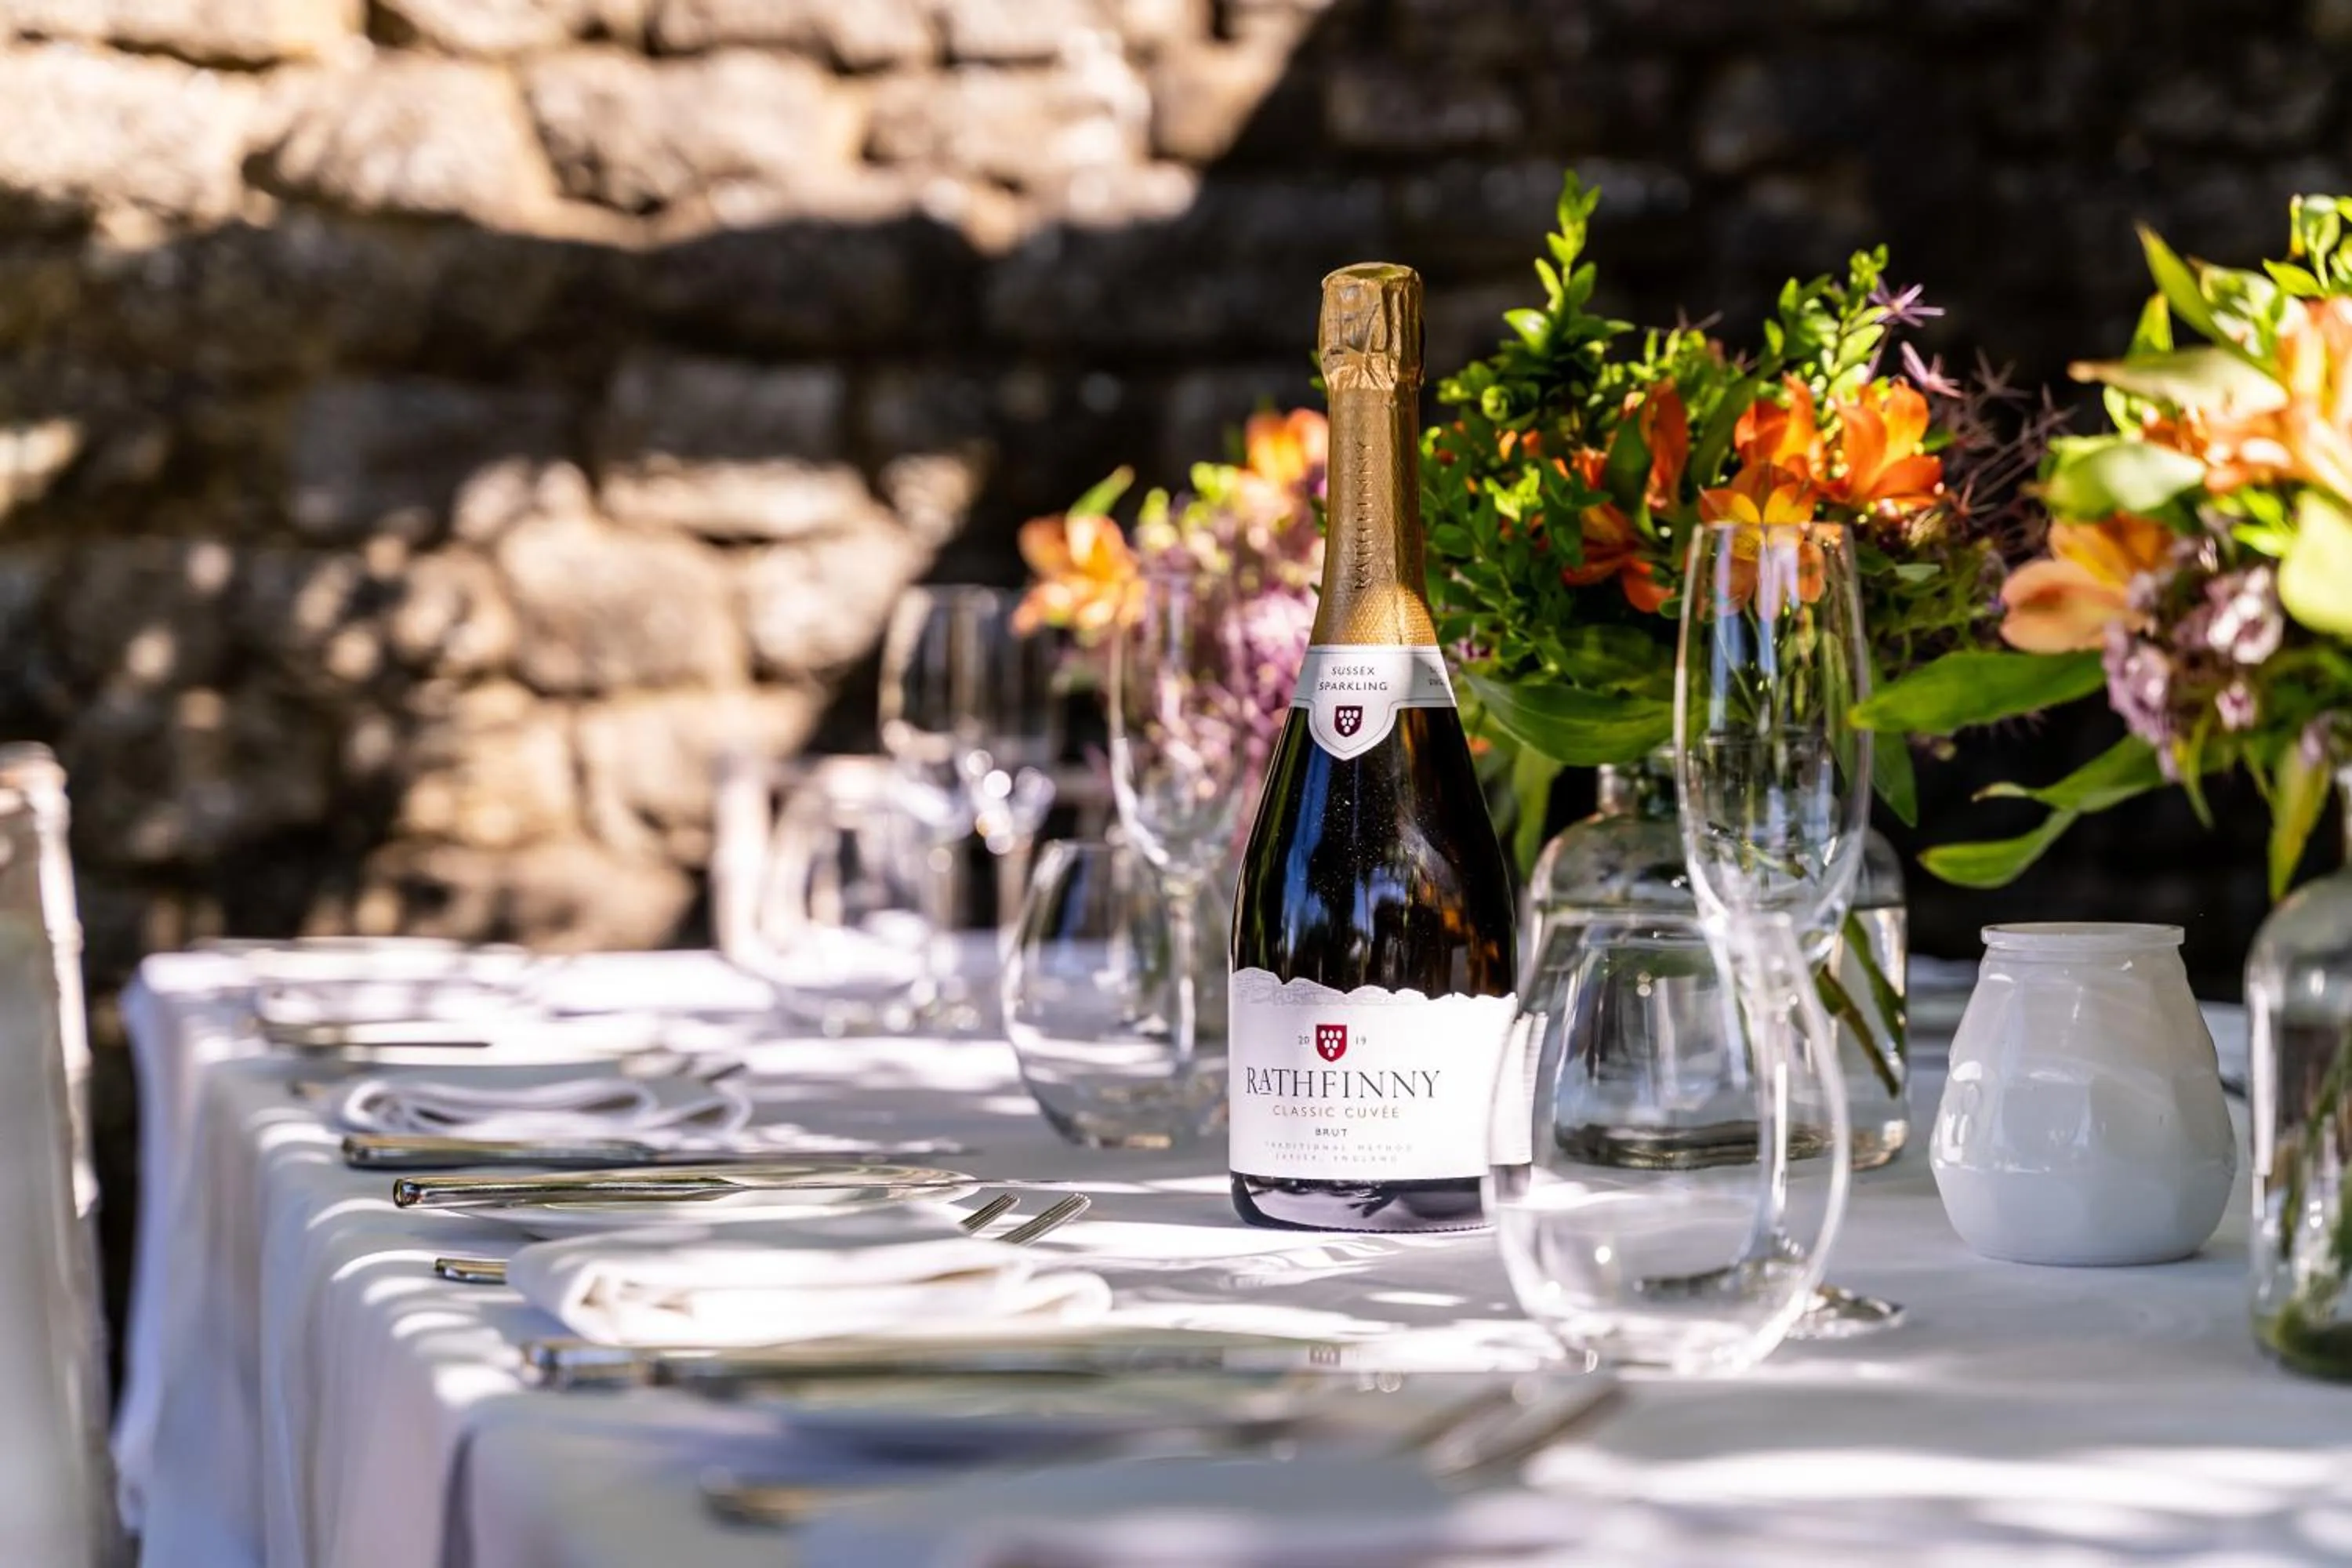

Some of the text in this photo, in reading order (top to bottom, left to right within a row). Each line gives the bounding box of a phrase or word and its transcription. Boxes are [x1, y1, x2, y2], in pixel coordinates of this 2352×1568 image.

[1331, 666, 1375, 676] SUSSEX
[1319, 681, 1388, 691] SPARKLING
[1298, 1035, 1367, 1047] 20 19
[1245, 1066, 1441, 1099] RATHFINNY
[1272, 1105, 1400, 1119] CLASSIC CUVÉE
[1315, 1127, 1348, 1137] BRUT
